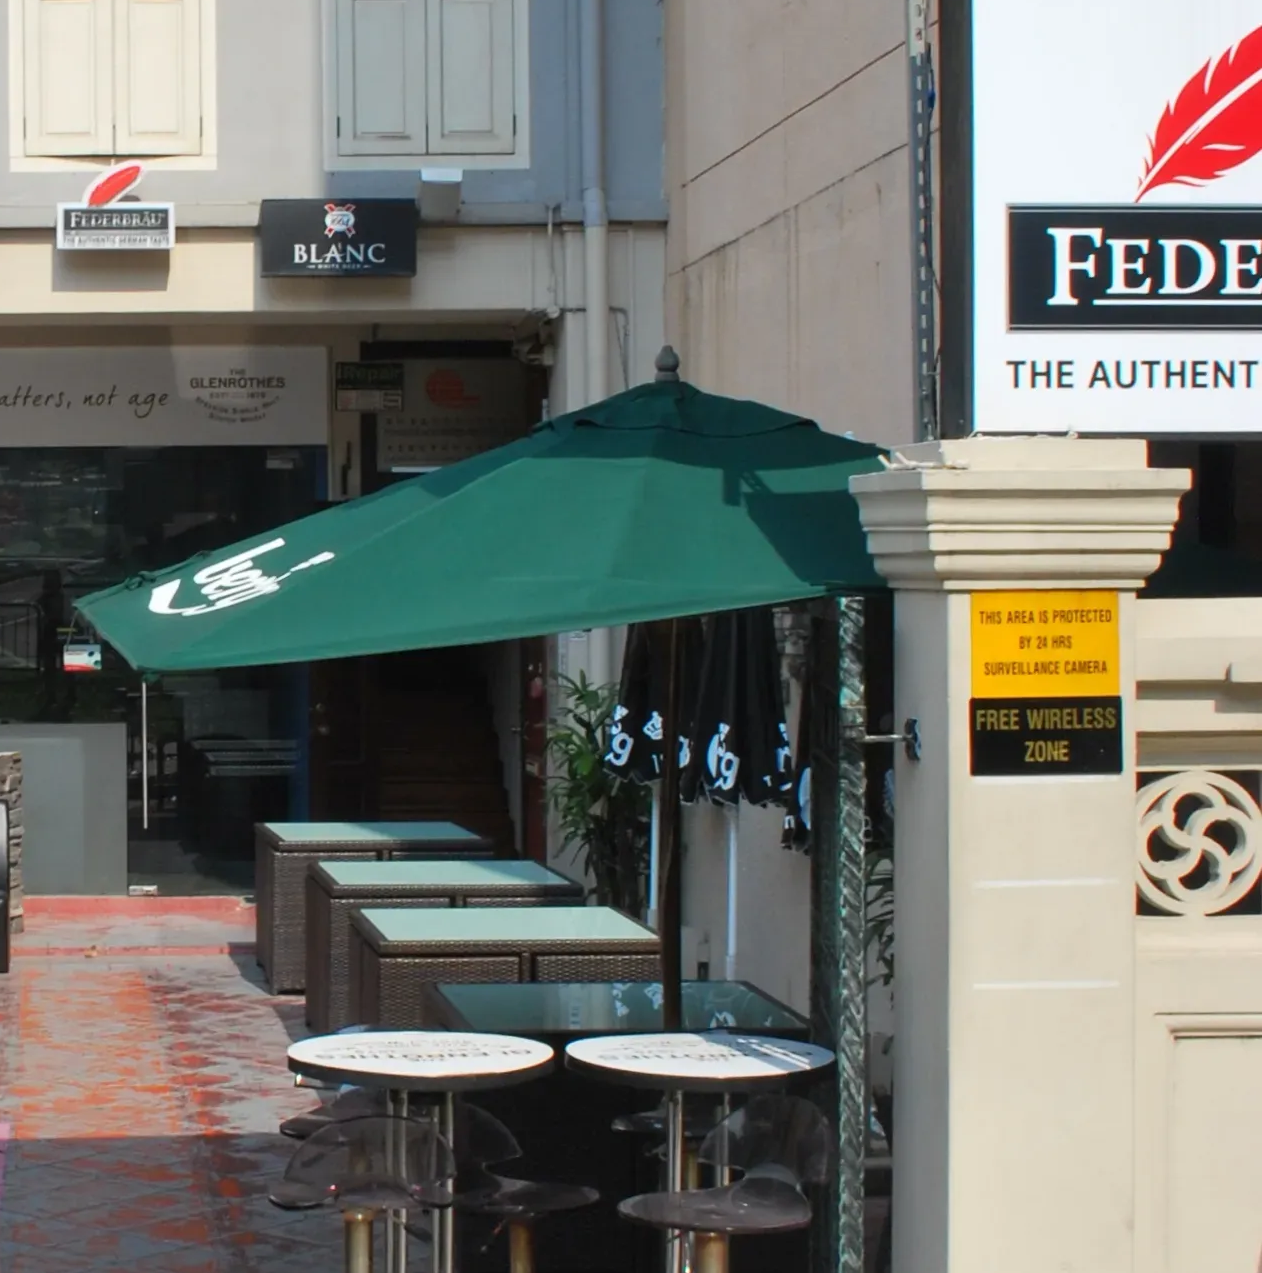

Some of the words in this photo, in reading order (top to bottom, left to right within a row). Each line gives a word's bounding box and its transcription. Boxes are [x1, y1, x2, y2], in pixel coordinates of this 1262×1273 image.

[293, 242, 386, 264] BLANC
[190, 376, 286, 389] GLENROTHES
[1006, 360, 1075, 389] THE
[1088, 359, 1260, 389] AUTHENT
[83, 384, 119, 407] not
[128, 392, 169, 419] age
[979, 610, 1002, 624] THIS
[1006, 610, 1035, 624] AREA
[1039, 610, 1049, 624] IS
[1053, 609, 1112, 623] PROTECTED
[1019, 636, 1032, 649] BY
[1036, 636, 1048, 649] 24
[1051, 635, 1072, 649] HRS
[984, 661, 1060, 676] SURVEILLANCE
[1064, 660, 1107, 674] CAMERA
[976, 709, 1020, 730] FREE
[1026, 707, 1117, 729] WIRELESS
[1024, 741, 1070, 762] ZONE
